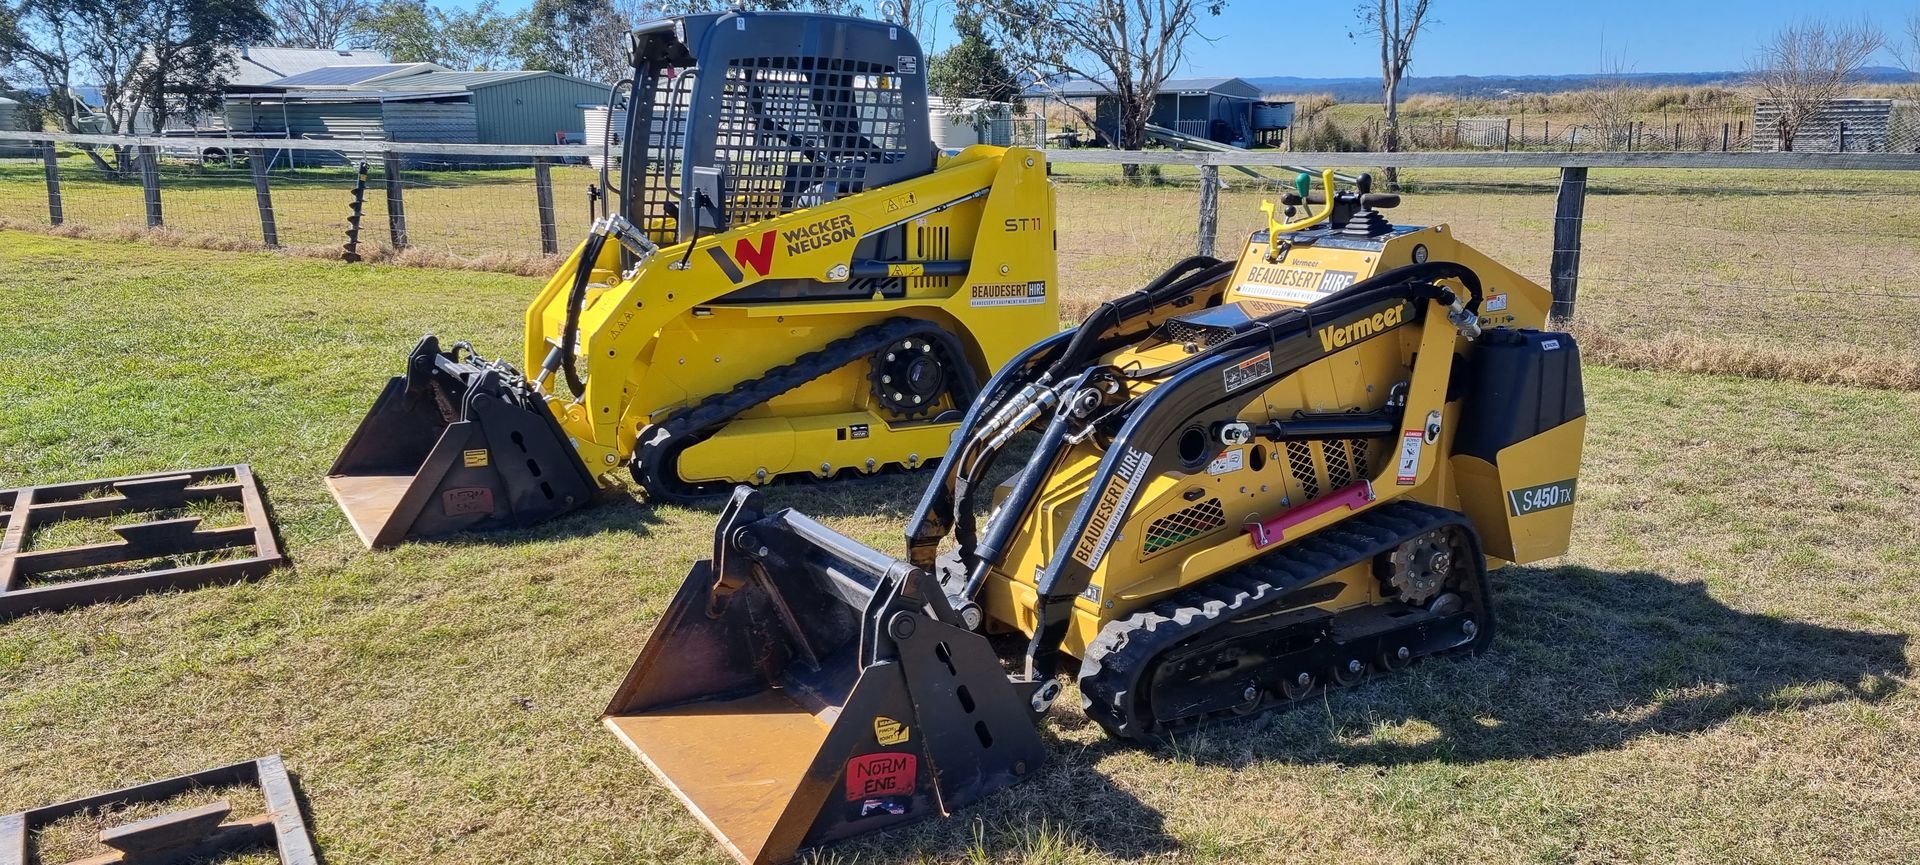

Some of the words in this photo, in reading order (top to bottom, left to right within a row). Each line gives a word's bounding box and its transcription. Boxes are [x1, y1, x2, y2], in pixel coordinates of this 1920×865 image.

[782, 214, 853, 243] WACKER
[787, 226, 856, 257] NEUSON
[1292, 258, 1319, 267] Vermeer
[972, 284, 1026, 298] BEAUDESERT
[1028, 282, 1045, 296] HIRE
[1247, 266, 1321, 289] BEAUDESERT
[1319, 272, 1353, 292] HIRE
[1319, 303, 1404, 353] Vermeer
[1075, 478, 1125, 562] BEAUDESERT
[1117, 446, 1142, 480] HIRE
[857, 758, 906, 778] NORM
[864, 776, 896, 794] ENG
